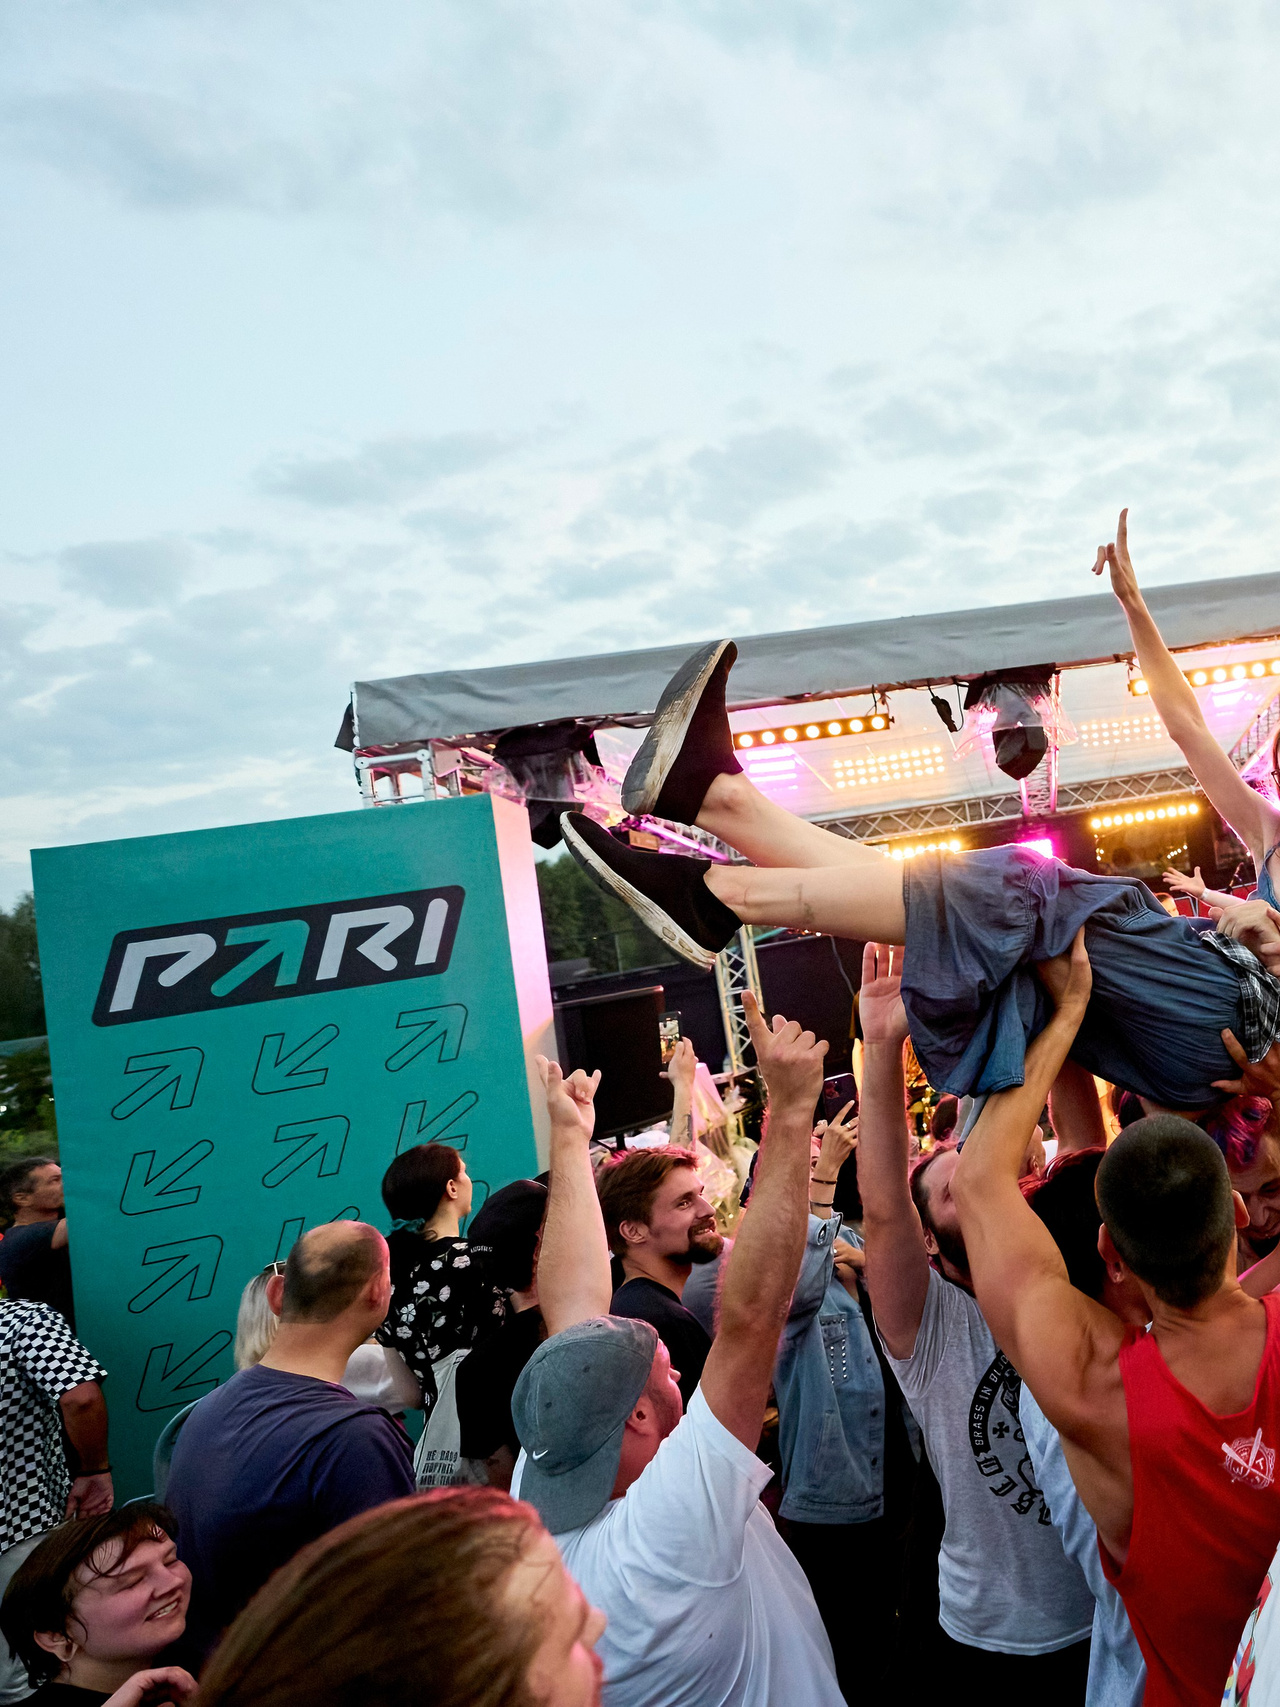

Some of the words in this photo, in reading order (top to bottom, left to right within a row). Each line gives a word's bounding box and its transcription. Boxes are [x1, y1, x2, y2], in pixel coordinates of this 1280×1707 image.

[109, 897, 449, 1013] PARI
[973, 1404, 985, 1446] BRASS
[979, 1385, 993, 1400] IN
